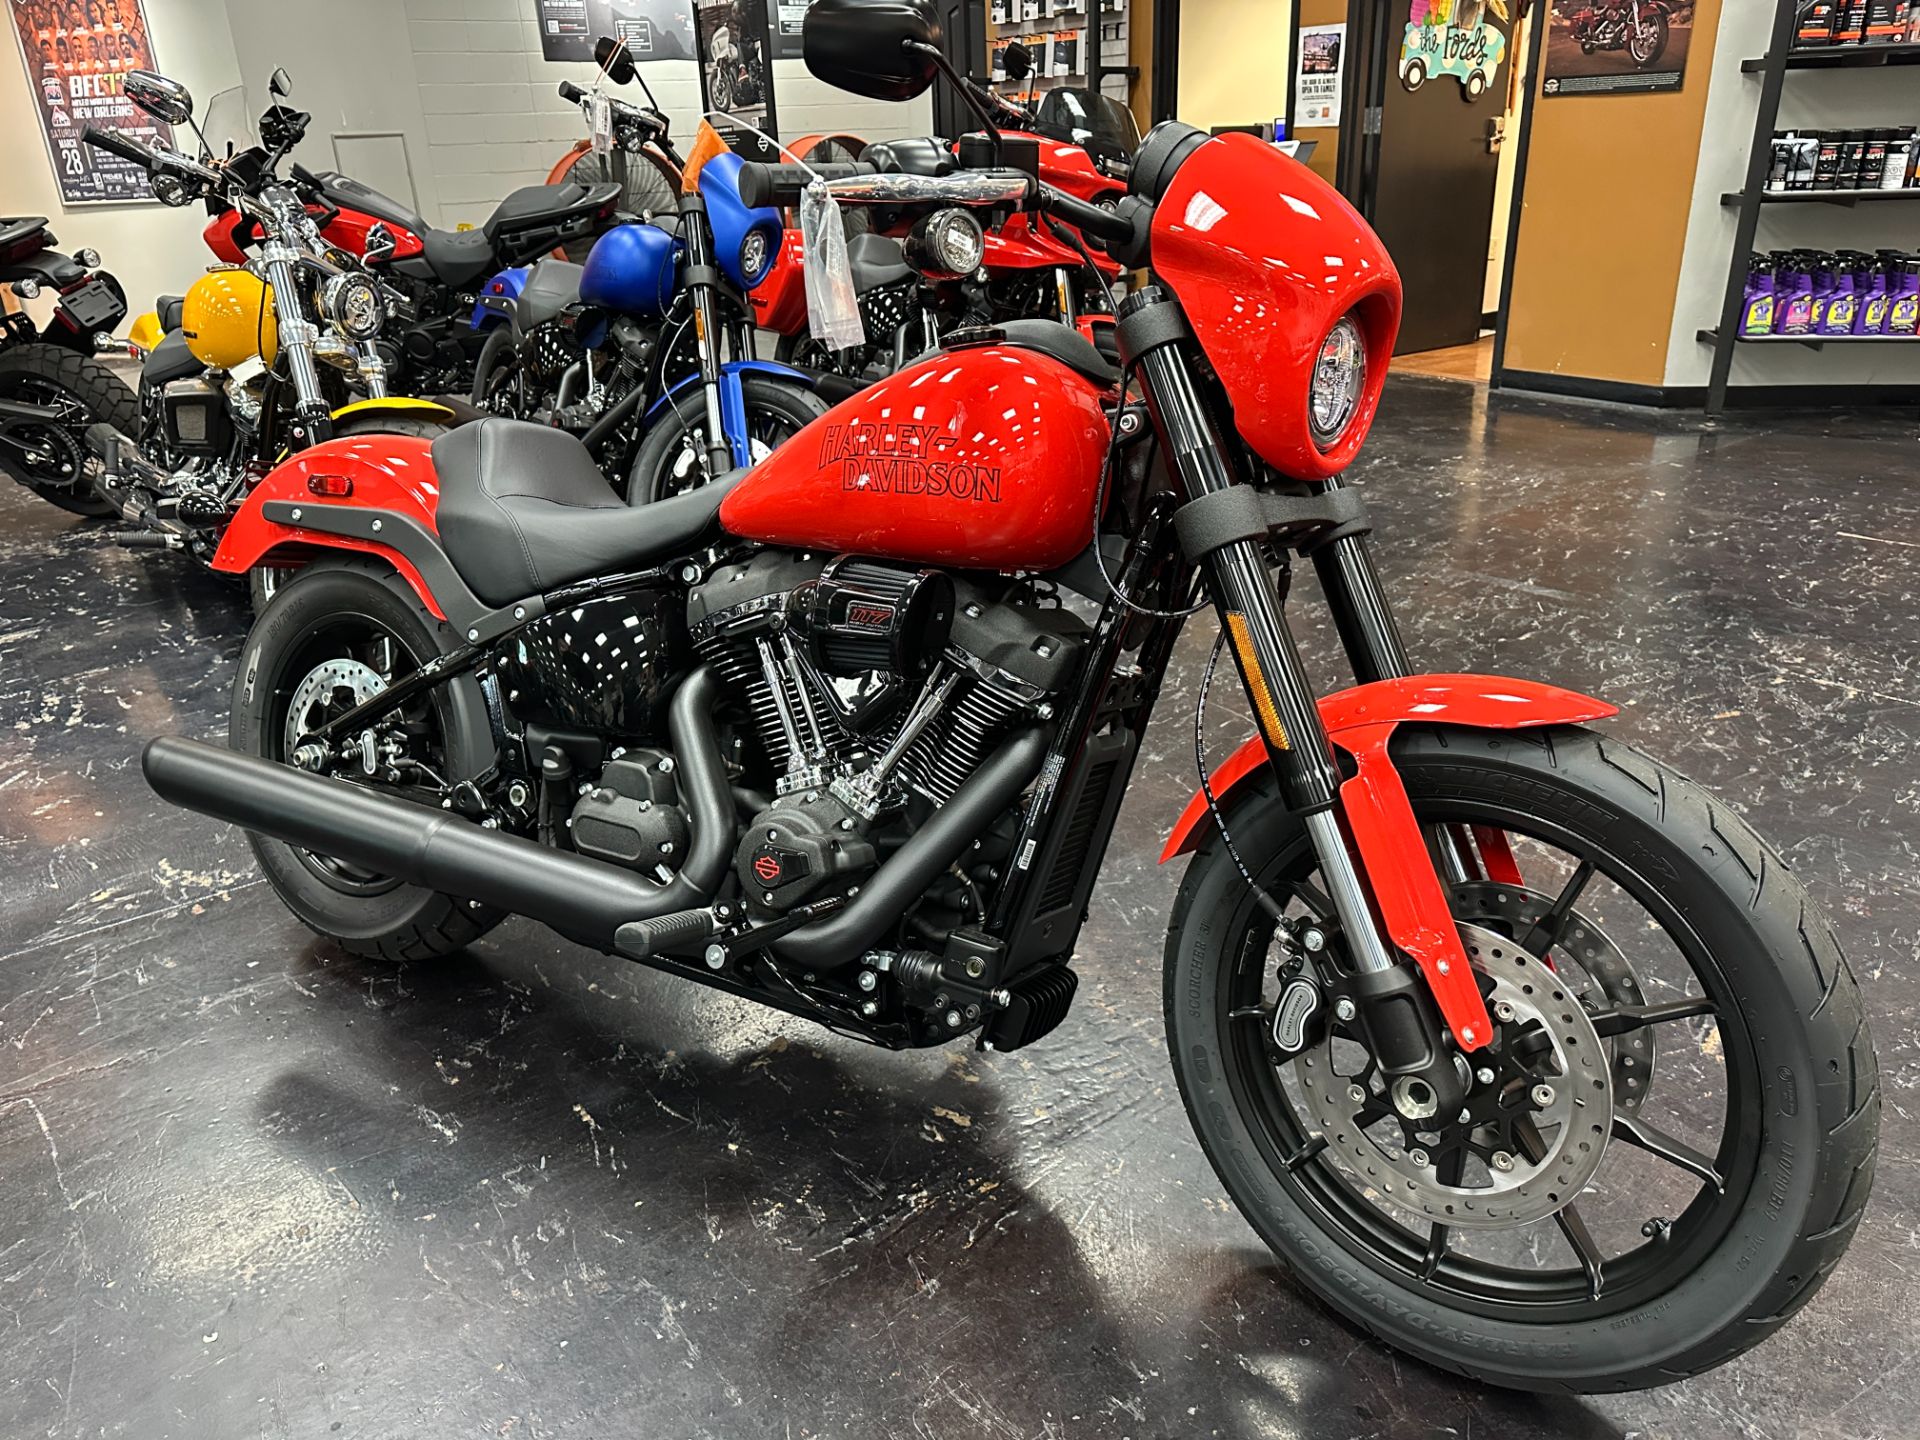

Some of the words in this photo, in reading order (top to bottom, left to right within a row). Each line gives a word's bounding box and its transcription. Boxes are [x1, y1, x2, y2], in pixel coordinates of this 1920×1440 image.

[1419, 25, 1440, 54] the
[1442, 22, 1488, 66] Fords
[1302, 86, 1312, 94] OPEN
[72, 107, 93, 119] NEW
[94, 105, 134, 118] ORLEANS
[50, 128, 80, 139] SATURDAY
[58, 138, 78, 149] MARCH
[61, 149, 84, 175] 28
[818, 424, 959, 471] HARLEY-
[842, 458, 1002, 503] DAVIDSON
[850, 608, 892, 624] 117
[1188, 941, 1208, 1017] SCORCHER
